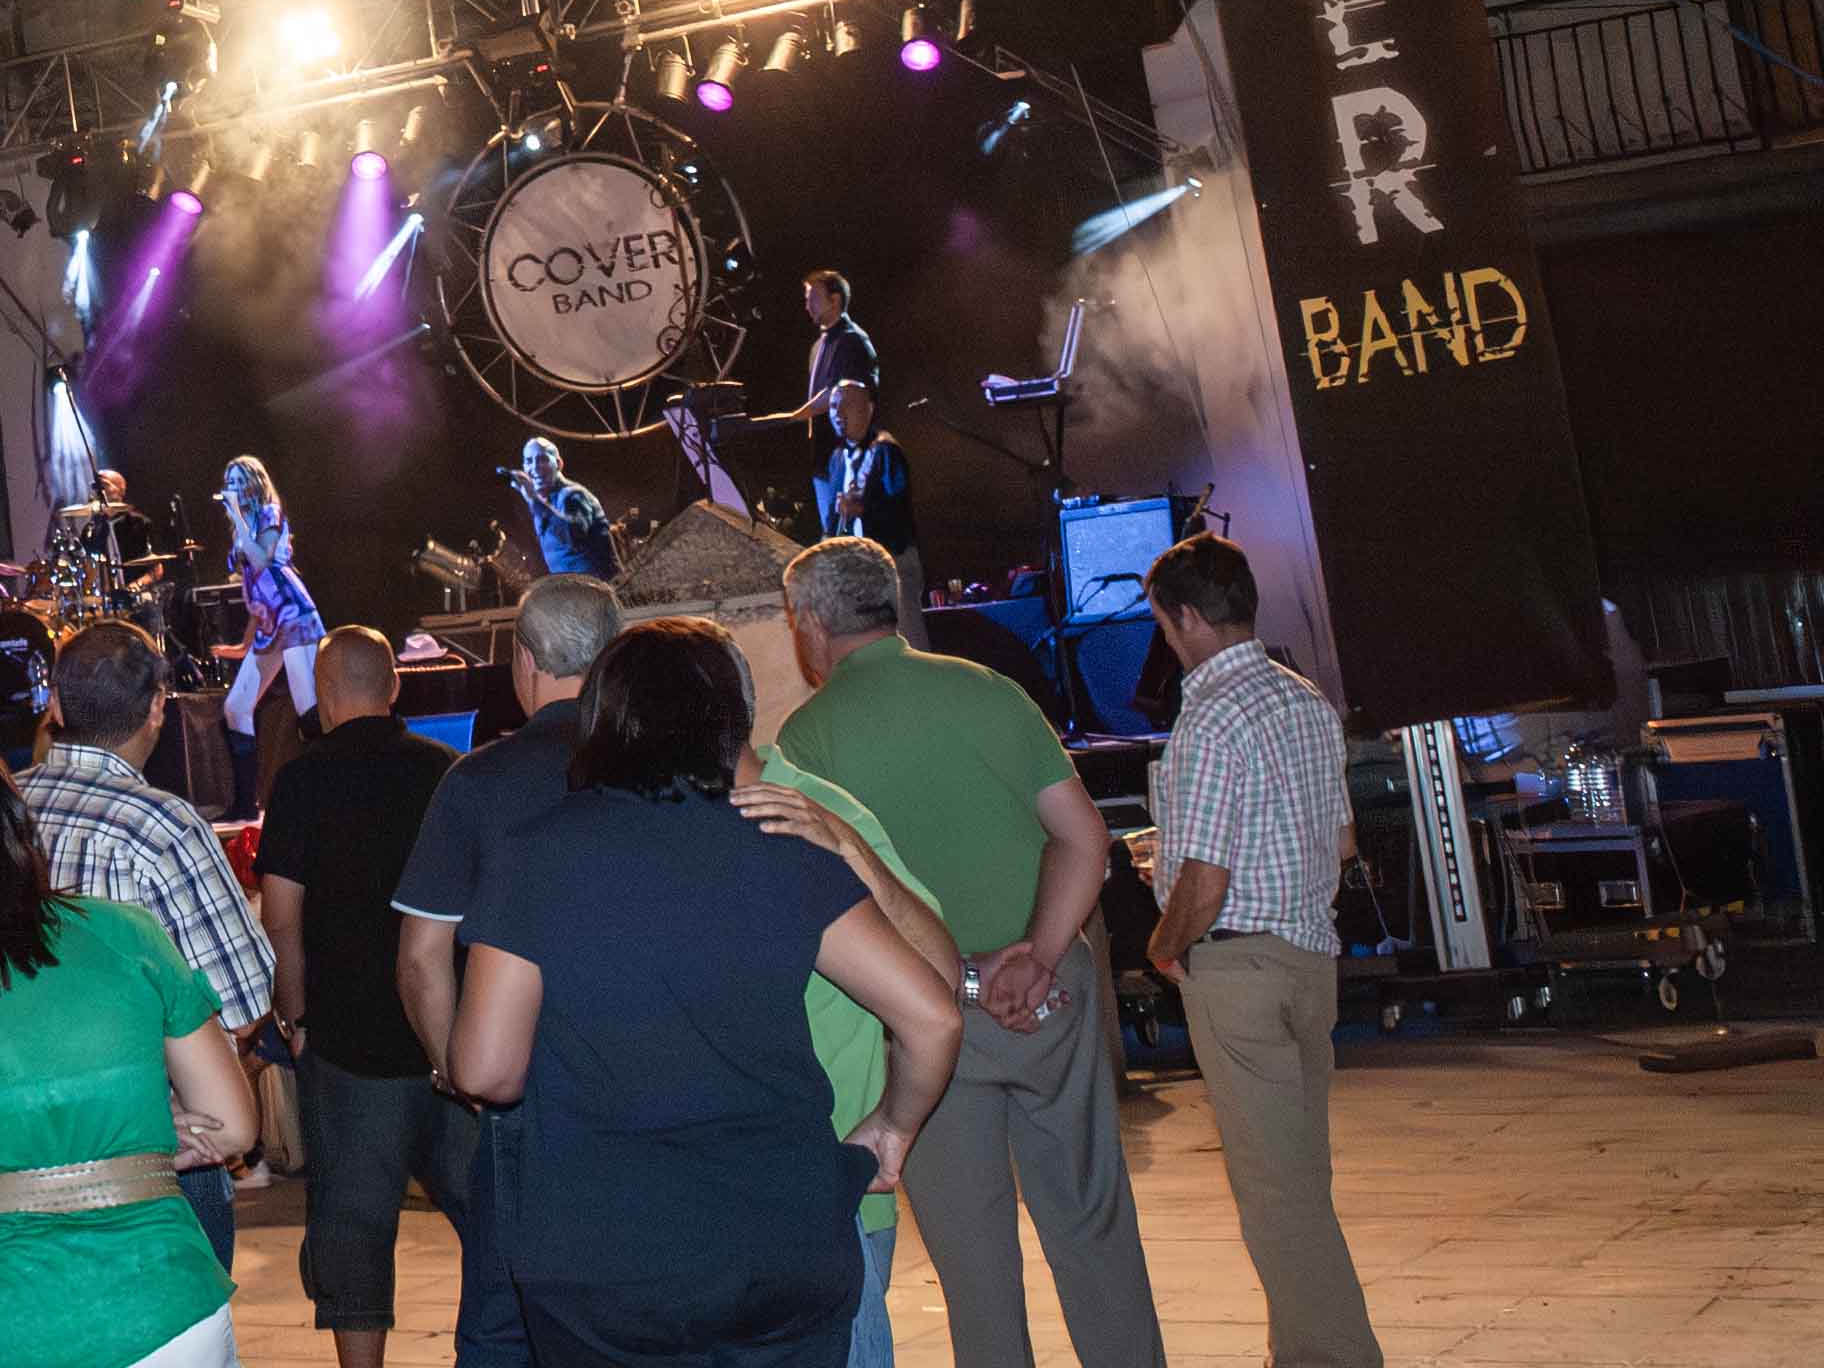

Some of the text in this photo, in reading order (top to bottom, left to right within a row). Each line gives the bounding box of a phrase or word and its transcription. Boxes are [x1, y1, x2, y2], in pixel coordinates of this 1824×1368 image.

[508, 230, 679, 292] COVER
[552, 280, 653, 314] BAND
[1298, 267, 1527, 391] BAND
